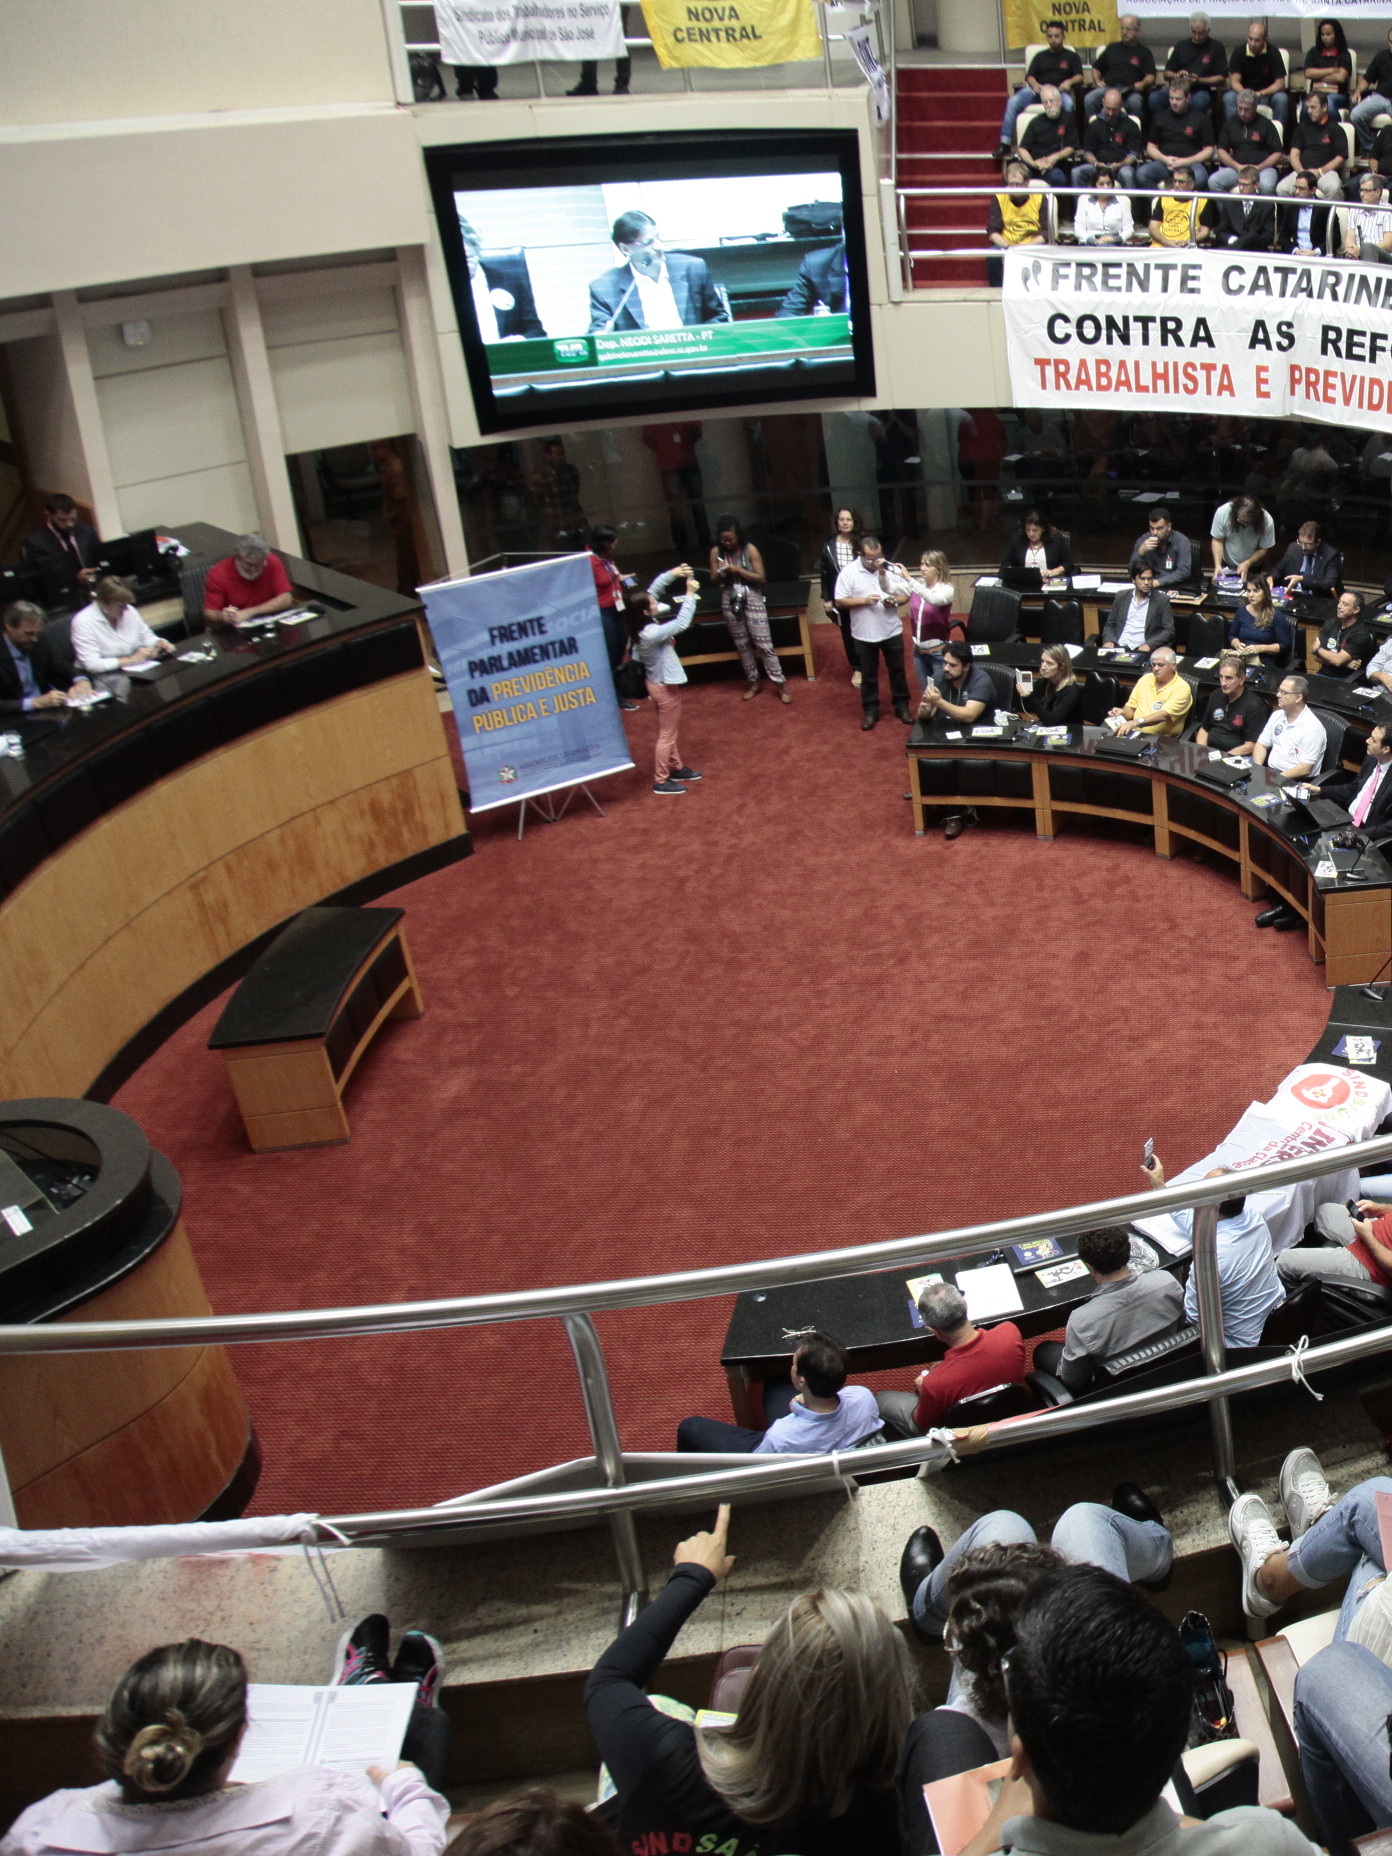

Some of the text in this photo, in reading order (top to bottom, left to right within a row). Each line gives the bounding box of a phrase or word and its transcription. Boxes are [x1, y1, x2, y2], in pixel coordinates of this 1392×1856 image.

[567, 7, 578, 18] no
[579, 3, 610, 18] Serviço
[686, 6, 740, 22] NOVA
[1051, 1, 1091, 16] NOVA
[558, 27, 574, 41] São
[575, 25, 595, 40] José
[673, 25, 763, 43] CENTRAL
[1040, 18, 1106, 33] CNTRAL
[652, 332, 694, 345] SARETTA
[1046, 312, 1216, 349] CONTRA
[1248, 319, 1296, 352] AS
[1033, 357, 1236, 397] TRABALHISTA
[1255, 364, 1271, 399] E
[488, 616, 547, 646] FRENTE
[467, 636, 579, 679] PARLAMENTAR
[467, 661, 591, 707] DA PREVIDÊNCIA
[472, 687, 596, 734] PÚBLICA E JUSTA
[1268, 1139, 1282, 1154] da
